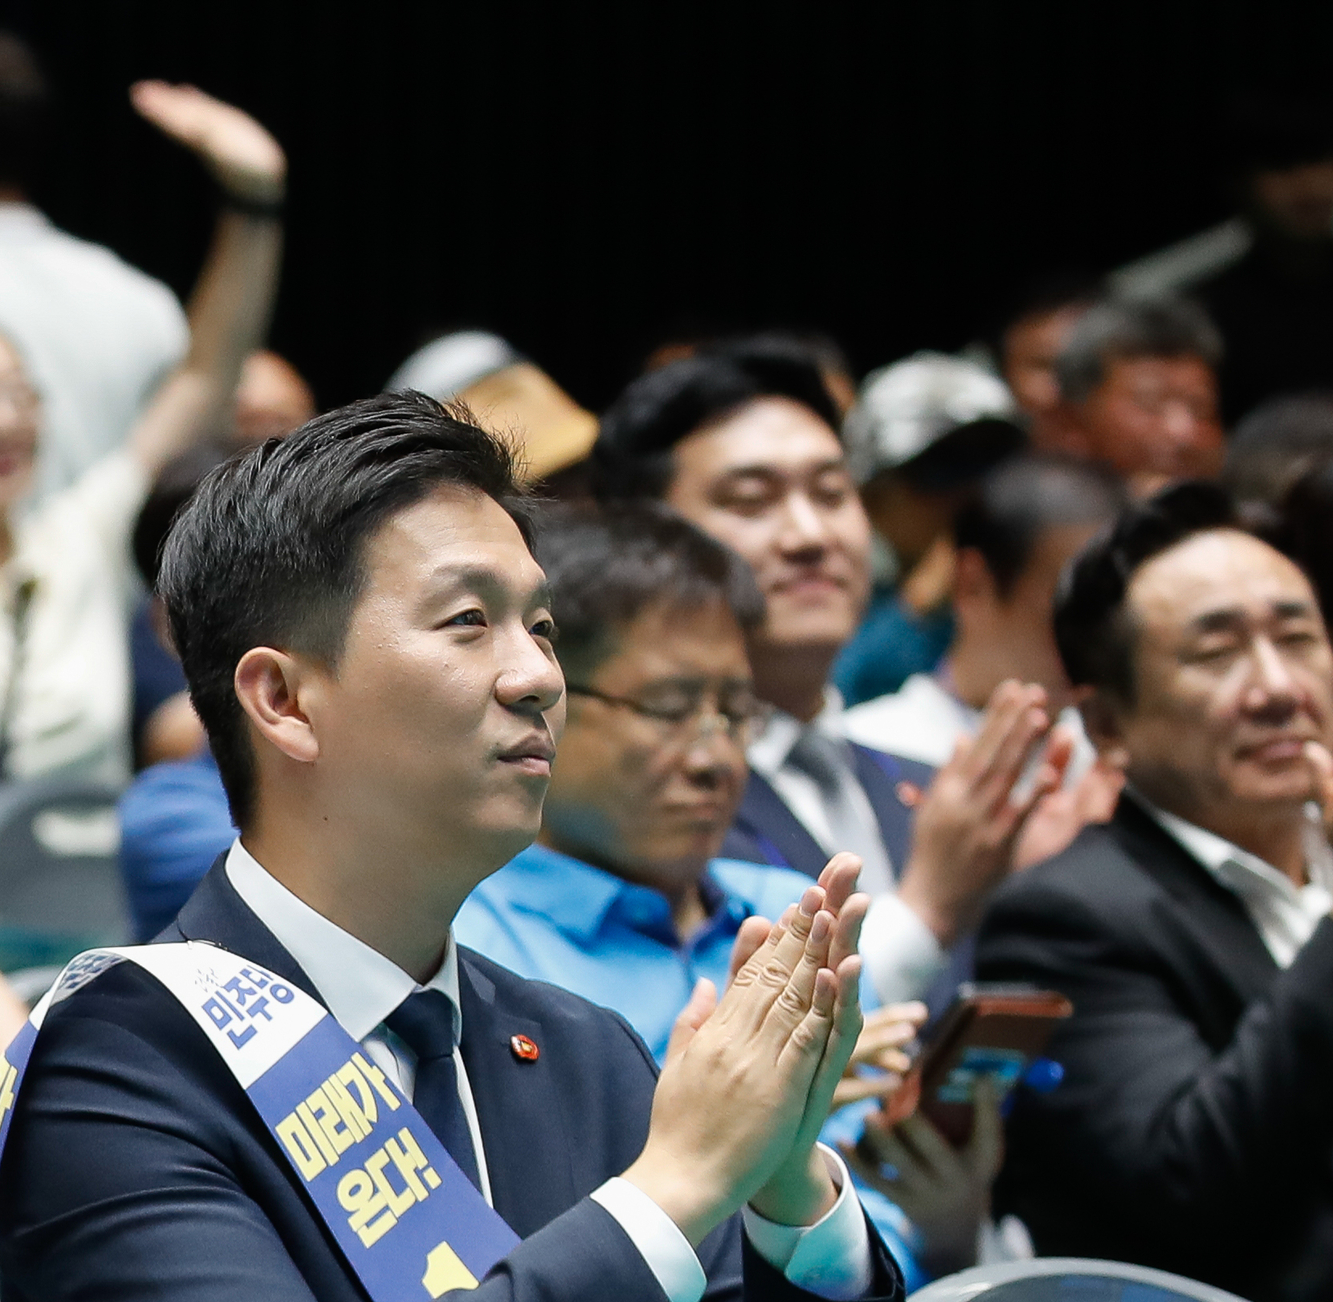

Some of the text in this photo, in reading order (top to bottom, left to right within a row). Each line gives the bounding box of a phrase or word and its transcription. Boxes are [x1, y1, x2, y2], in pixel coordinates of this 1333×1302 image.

[201, 965, 296, 1051] 민주당
[275, 1052, 402, 1183] 미래가
[336, 1127, 444, 1250] 온다!
